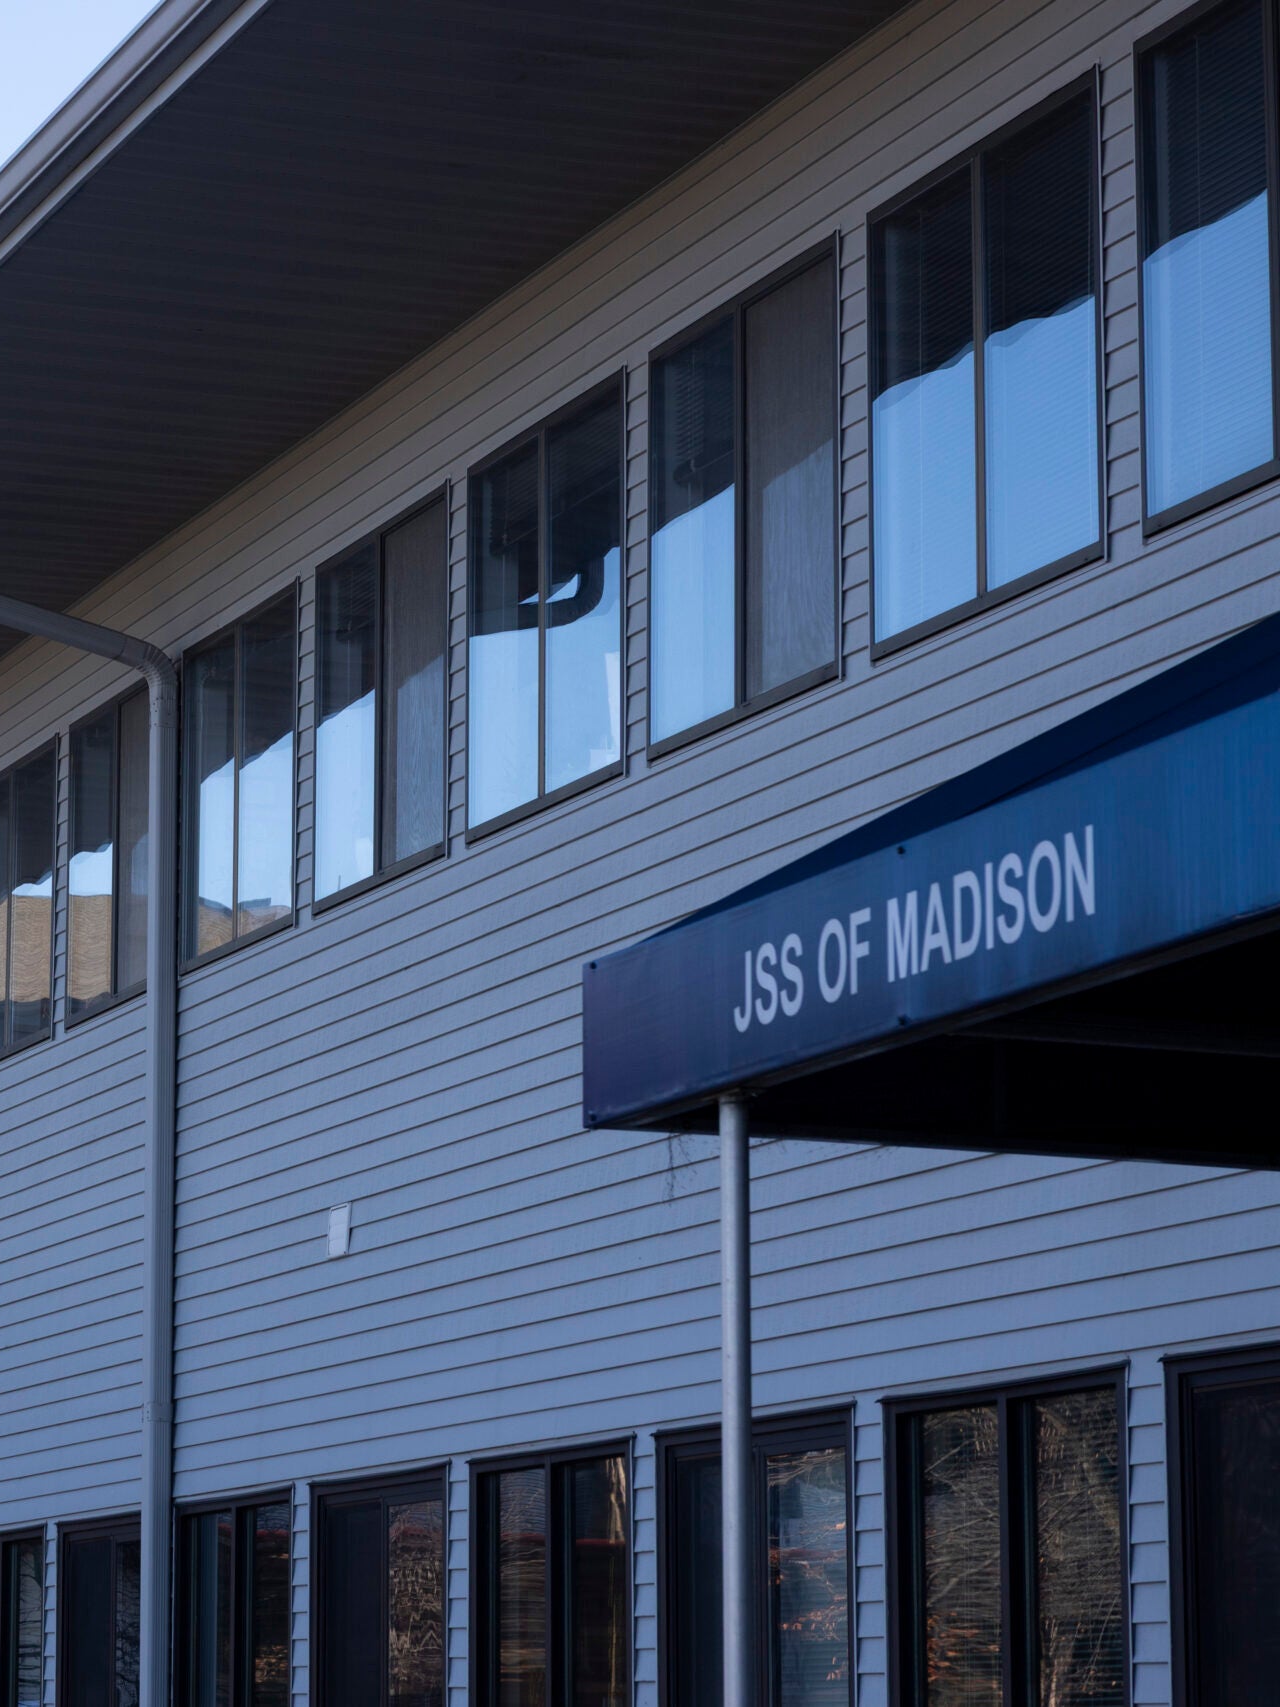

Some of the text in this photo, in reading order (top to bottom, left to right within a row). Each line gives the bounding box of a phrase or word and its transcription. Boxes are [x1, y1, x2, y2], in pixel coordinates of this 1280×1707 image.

[733, 824, 1096, 1033] JSS OF MADISON
